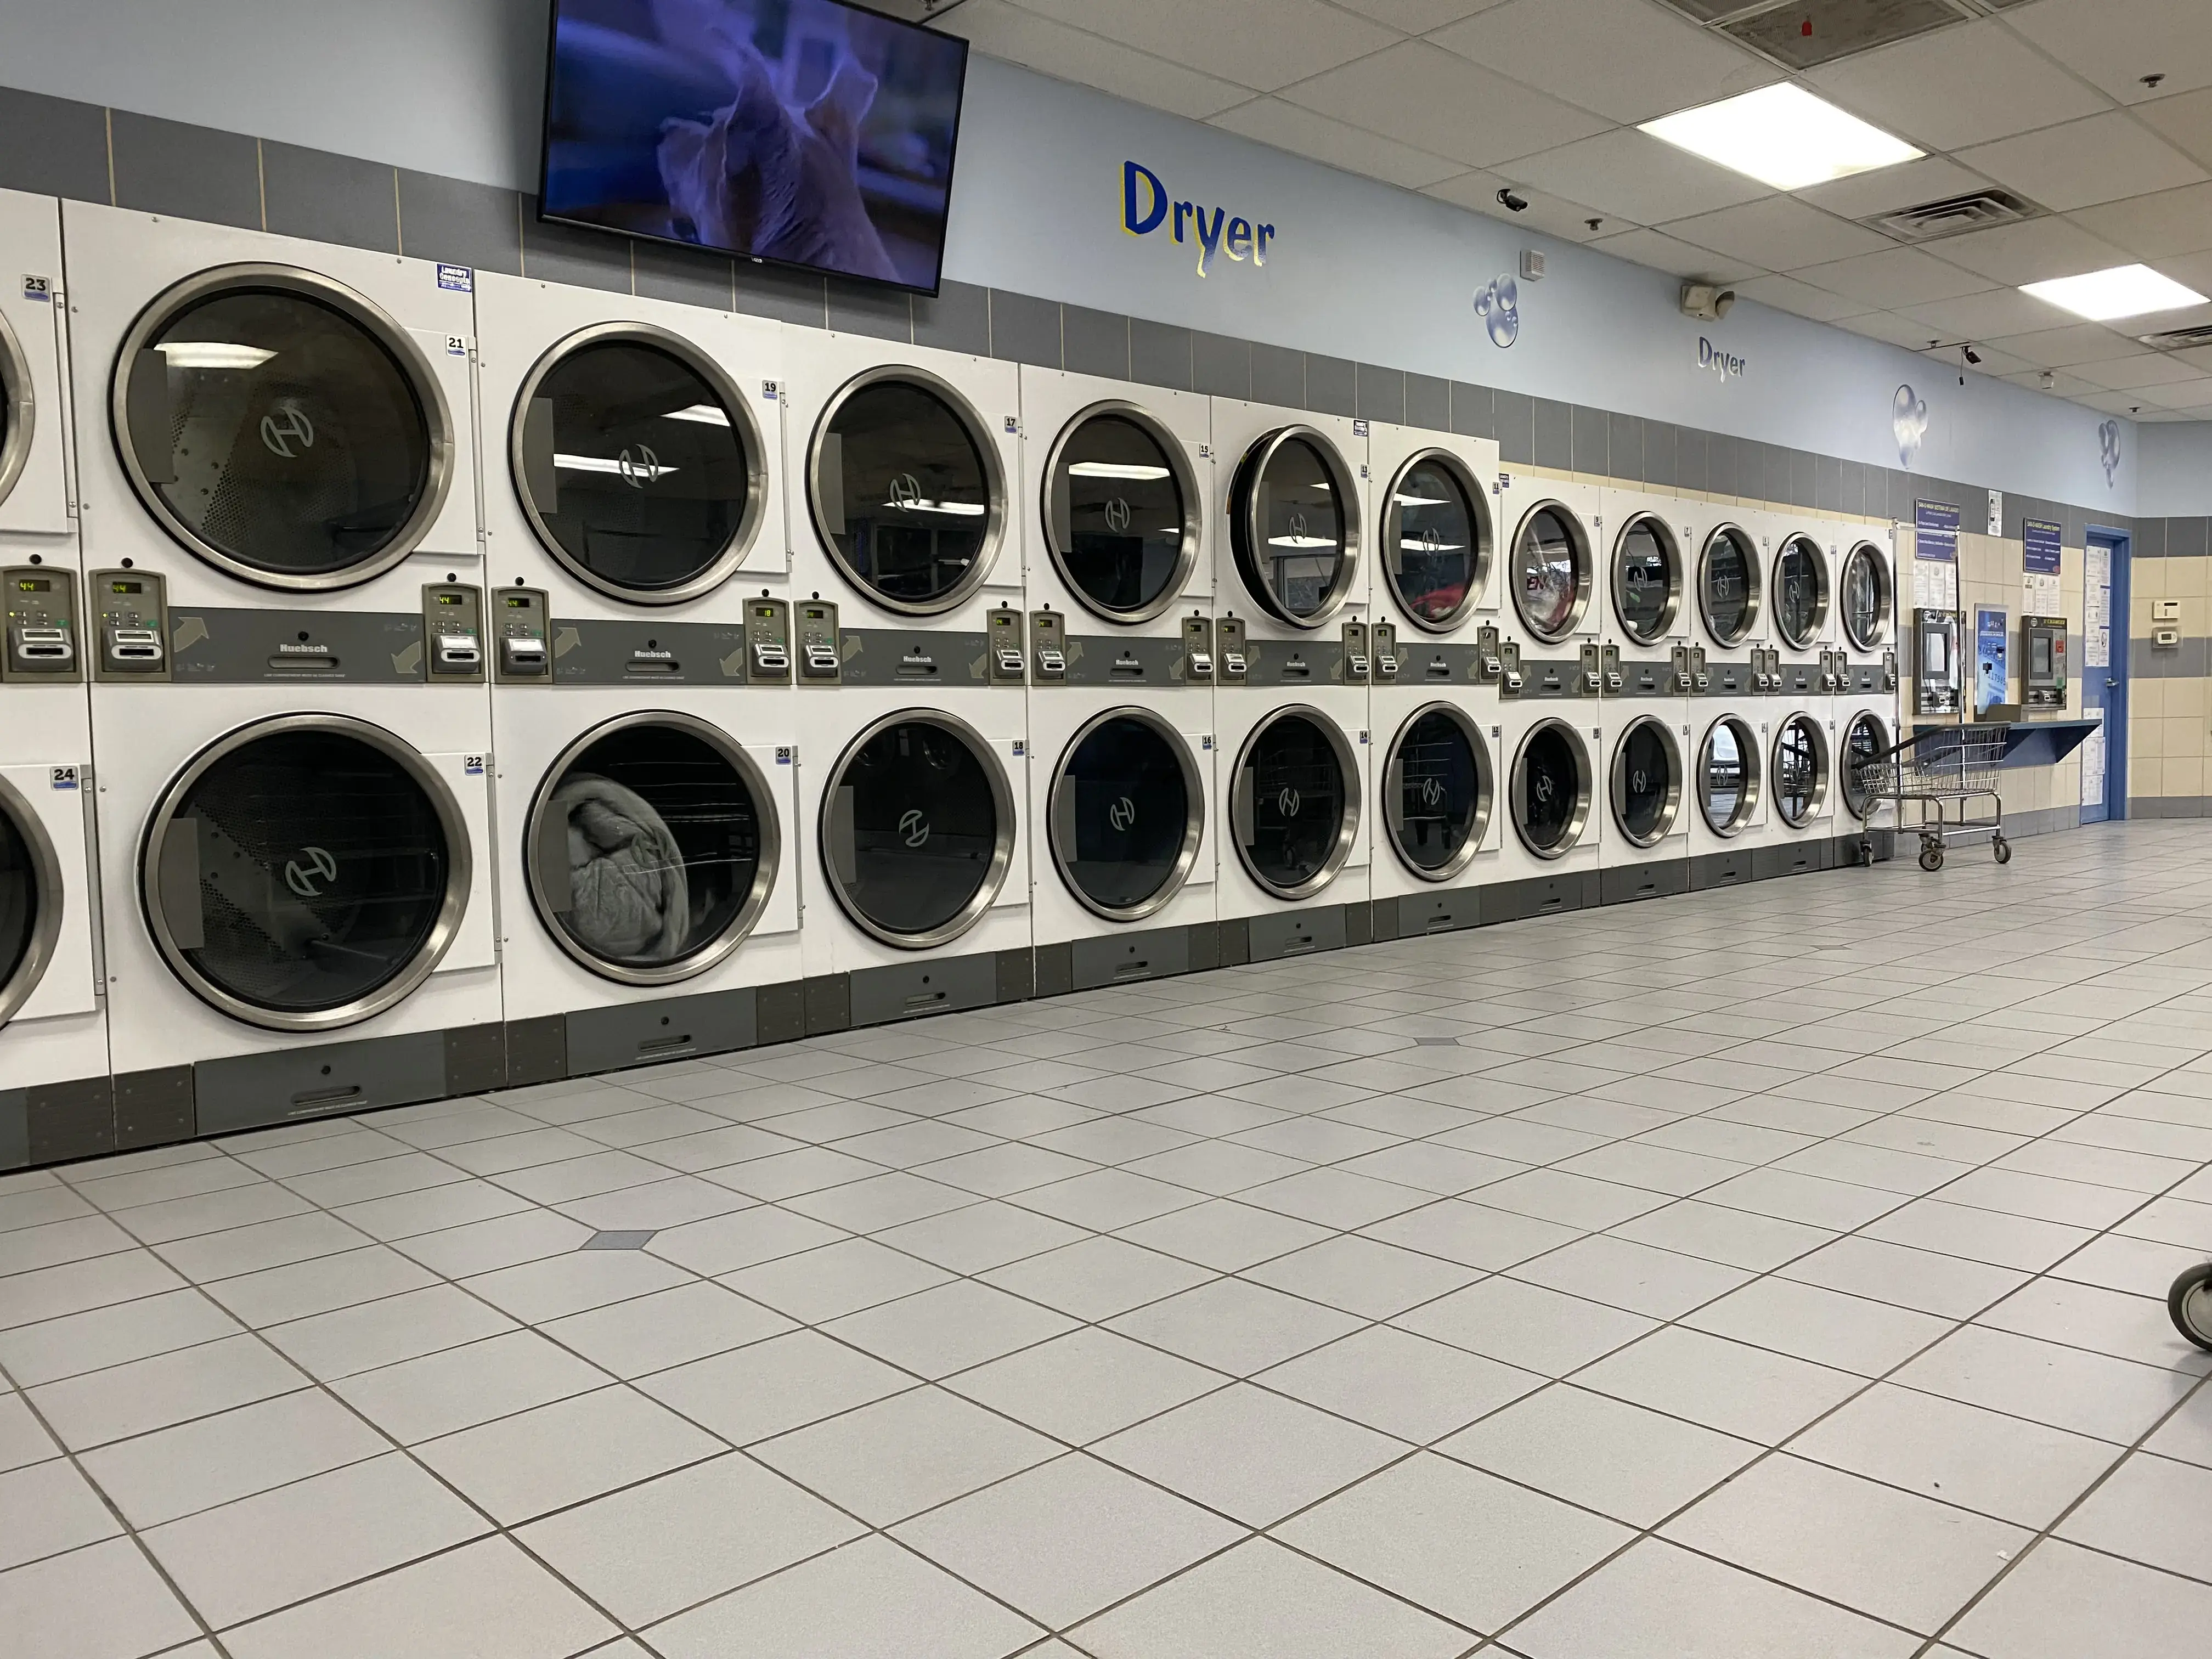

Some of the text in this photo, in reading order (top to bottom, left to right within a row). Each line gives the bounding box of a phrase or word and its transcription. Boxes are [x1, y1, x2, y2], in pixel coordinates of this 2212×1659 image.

[1120, 160, 1275, 279] Dryer
[441, 266, 467, 277] Laundry
[26, 277, 46, 291] 23
[449, 337, 464, 348] 21
[1698, 336, 1745, 383] Dryer
[765, 382, 776, 392] 19
[1007, 417, 1016, 426] 17
[1200, 445, 1209, 453] 15
[280, 644, 328, 652] Huebsch
[1203, 736, 1212, 744] 16
[1014, 742, 1024, 750] 18
[777, 748, 789, 758] 20
[467, 757, 482, 767] 22
[54, 768, 75, 781] 24
